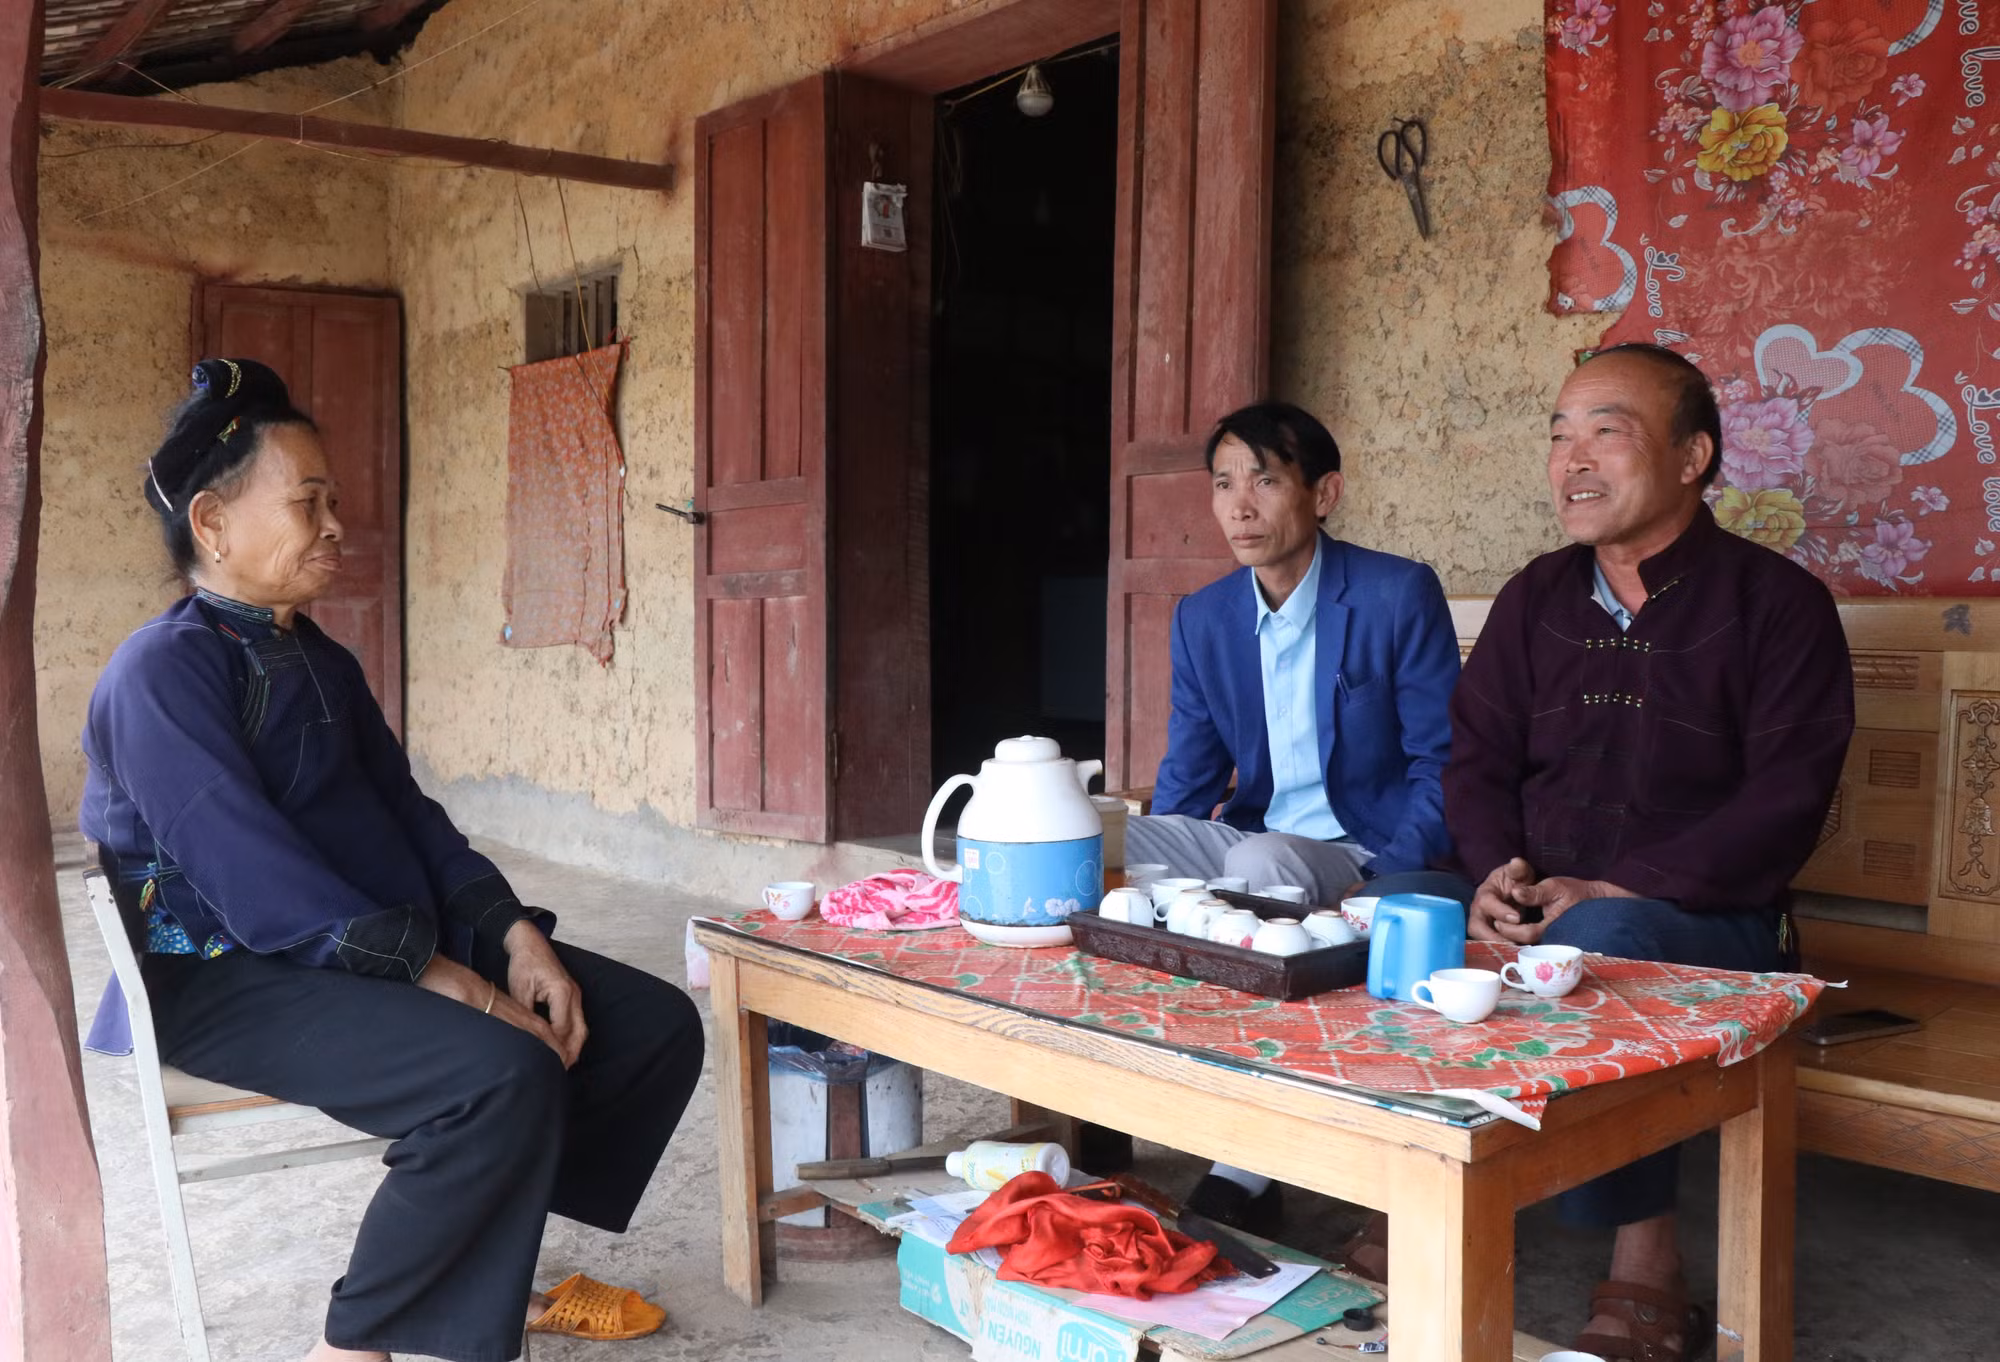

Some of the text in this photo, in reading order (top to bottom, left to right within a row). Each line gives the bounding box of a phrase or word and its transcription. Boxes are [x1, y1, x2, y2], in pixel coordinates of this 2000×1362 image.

[1645, 246, 1686, 318] Love
[1962, 384, 2000, 464] Love
[1062, 1331, 1123, 1362] ami
